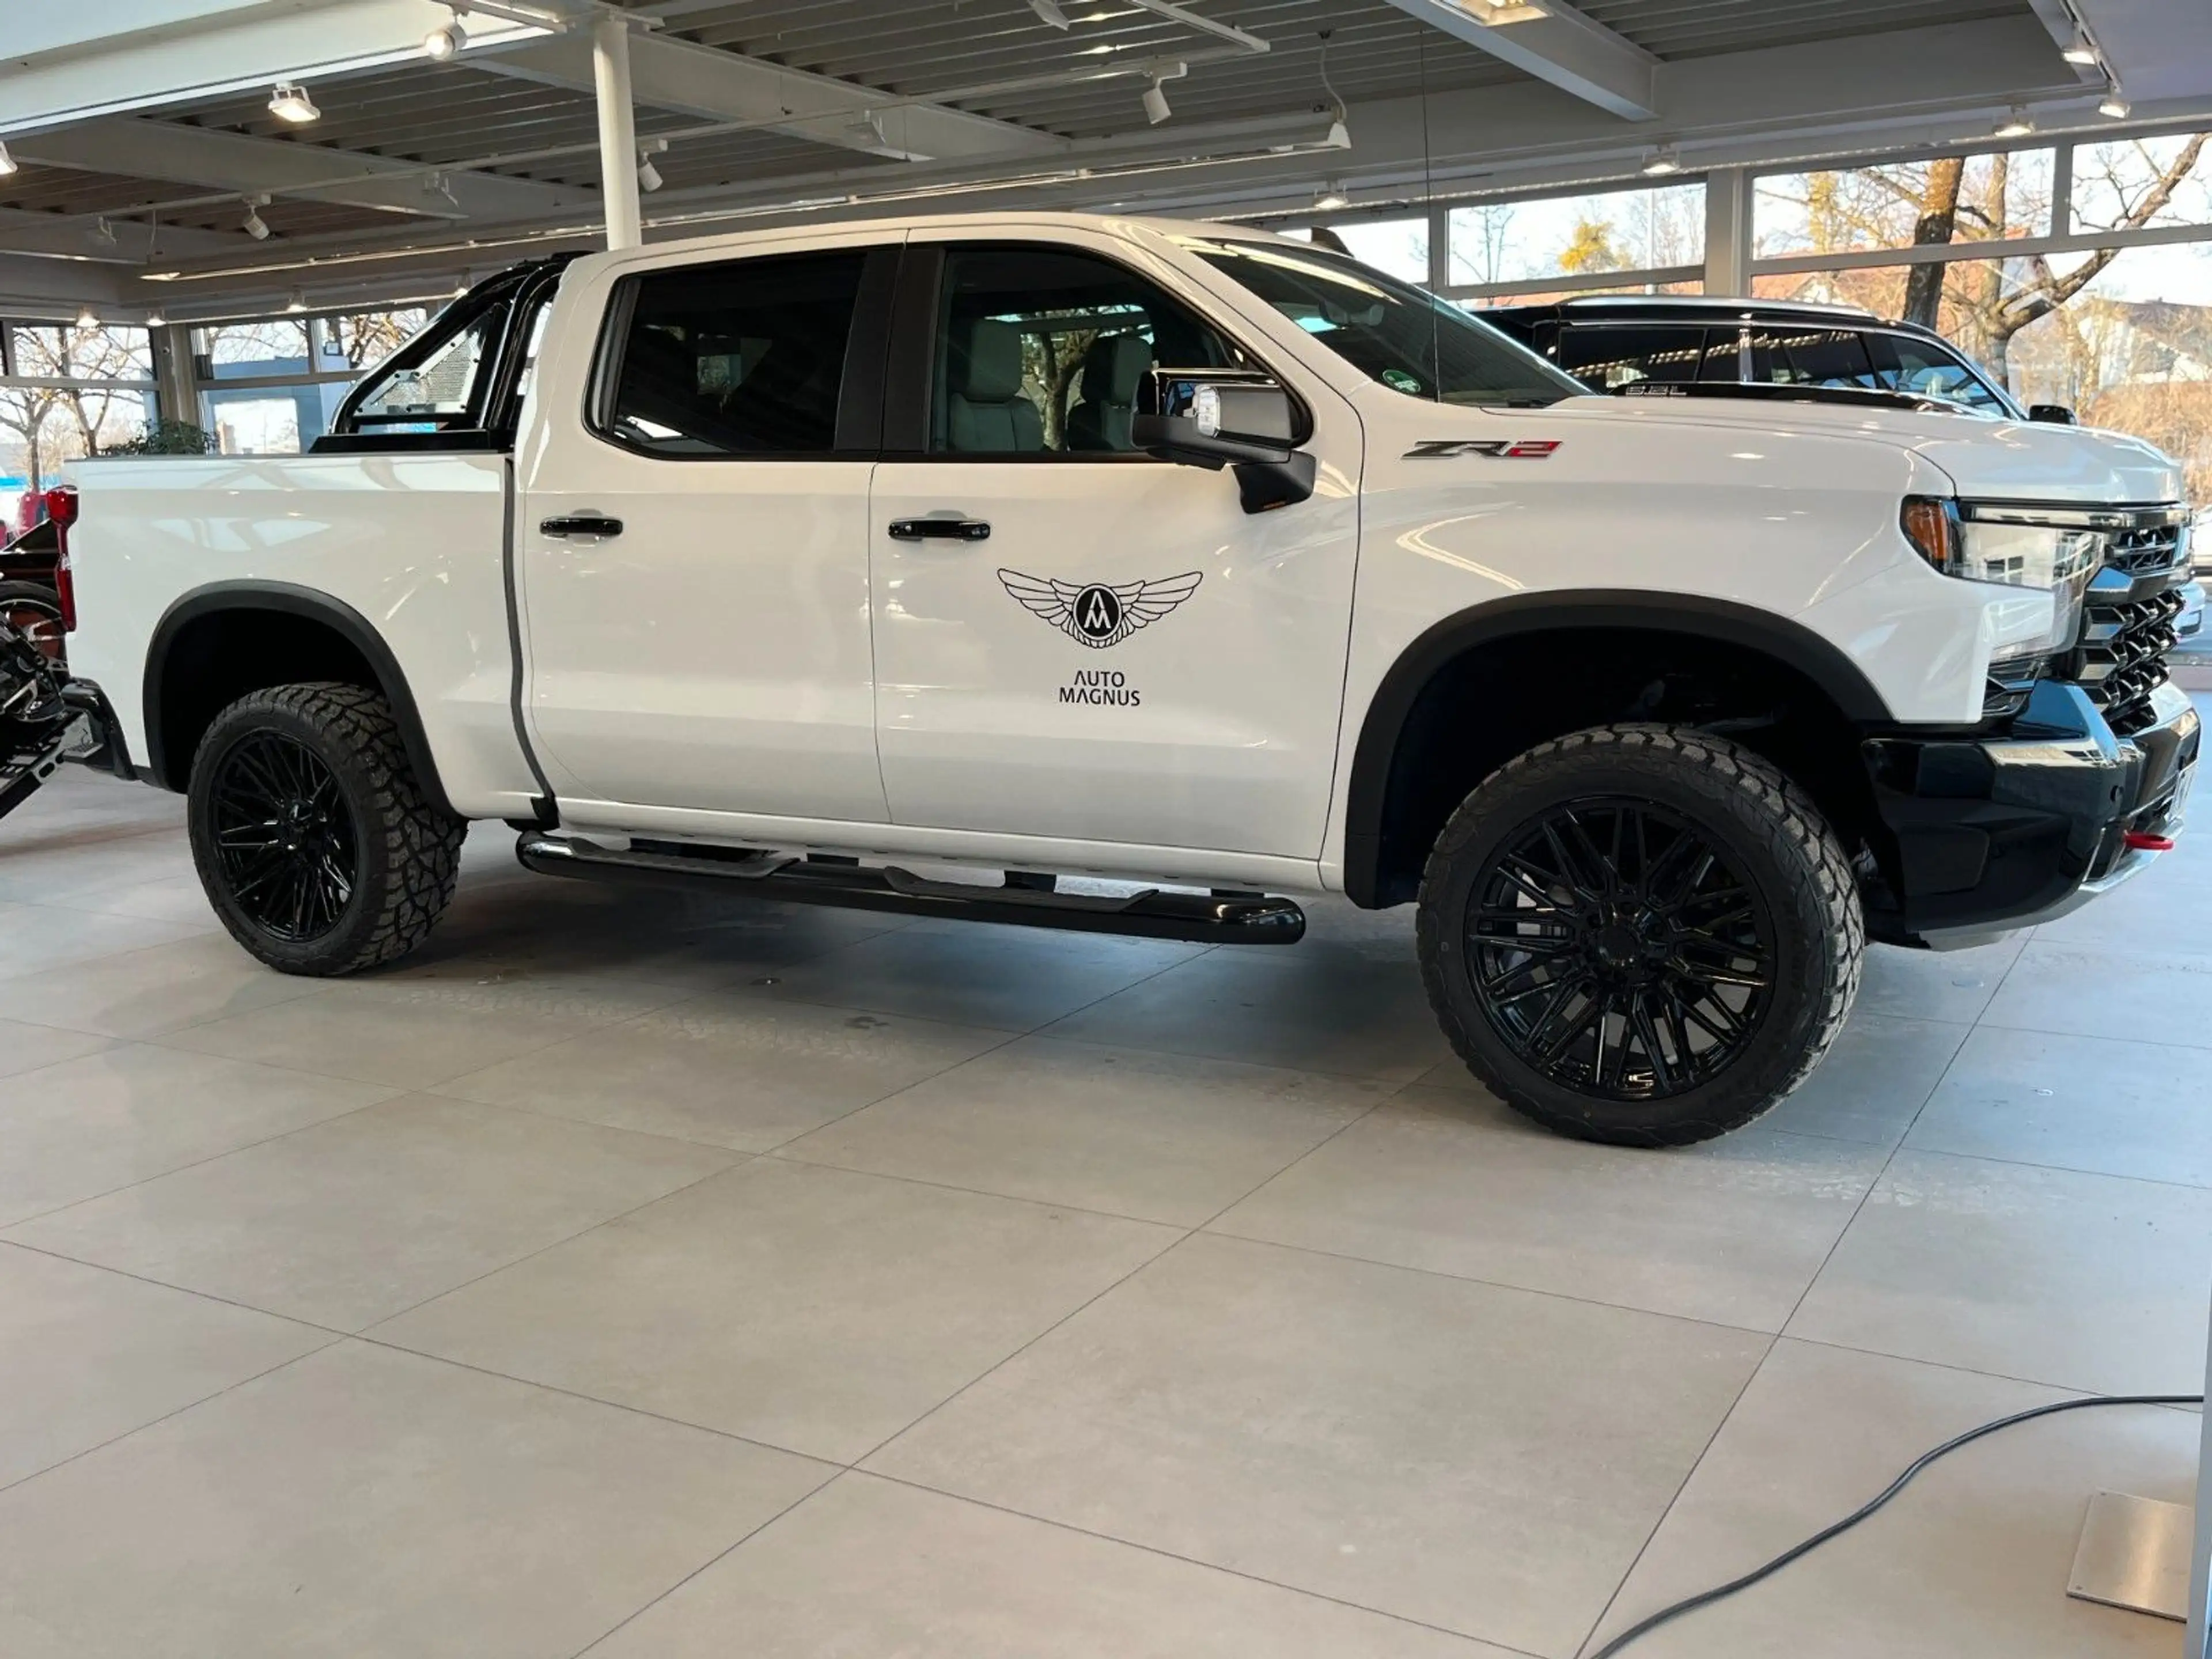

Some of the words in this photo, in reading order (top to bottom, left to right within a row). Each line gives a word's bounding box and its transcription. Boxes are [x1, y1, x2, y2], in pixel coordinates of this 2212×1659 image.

[1401, 440, 1563, 459] ZR2
[1074, 670, 1125, 688] AUTO
[1059, 687, 1141, 707] MAGNUS
